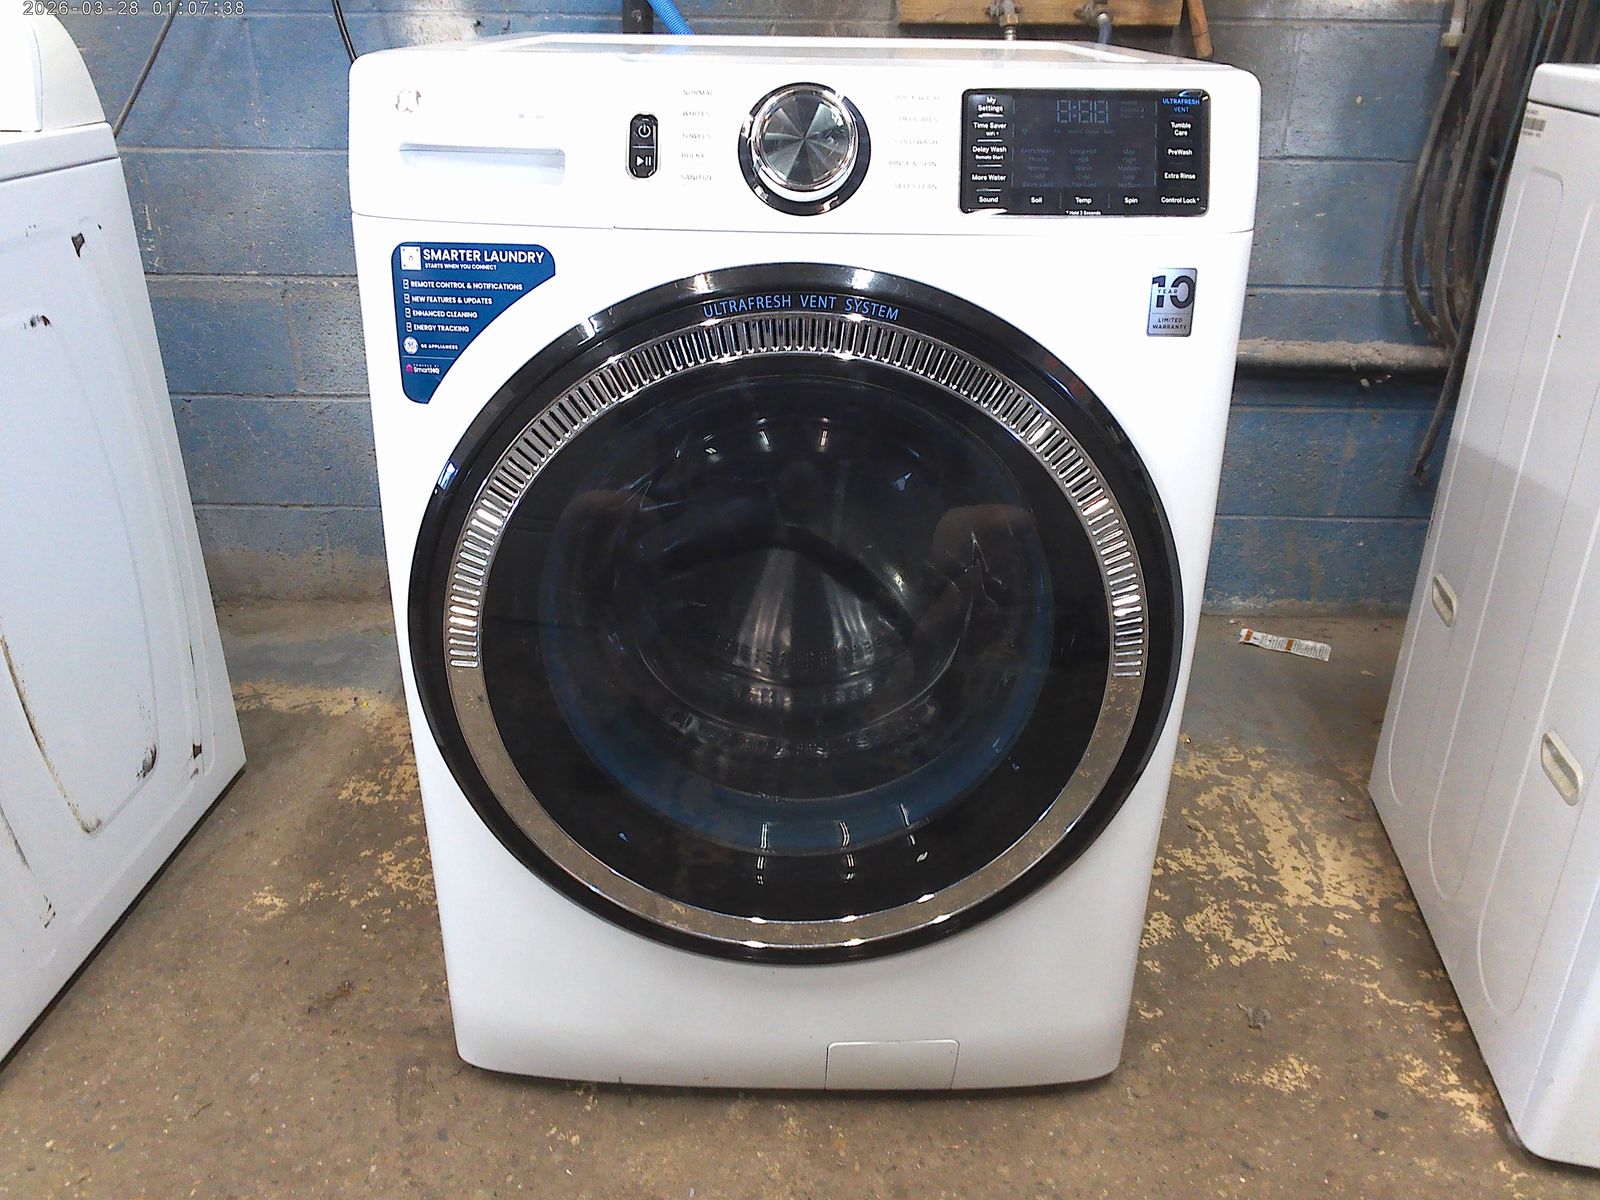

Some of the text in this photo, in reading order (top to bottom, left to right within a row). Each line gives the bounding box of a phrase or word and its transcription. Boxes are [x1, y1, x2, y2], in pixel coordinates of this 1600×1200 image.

[986, 96, 997, 105] My
[978, 105, 1004, 113] Settings
[972, 146, 989, 154] Delay
[1180, 172, 1196, 180] Rinse
[1030, 196, 1043, 204] Soil
[1124, 197, 1138, 205] Spin
[423, 249, 545, 264] SMARTER LAUNDRY
[473, 283, 523, 291] NOTIFICATIONS
[1152, 275, 1196, 309] 10
[463, 297, 493, 305] UPDATES
[703, 294, 899, 321] ULTRAFRESH VENT SYSTEM
[446, 310, 478, 318] CLEANING
